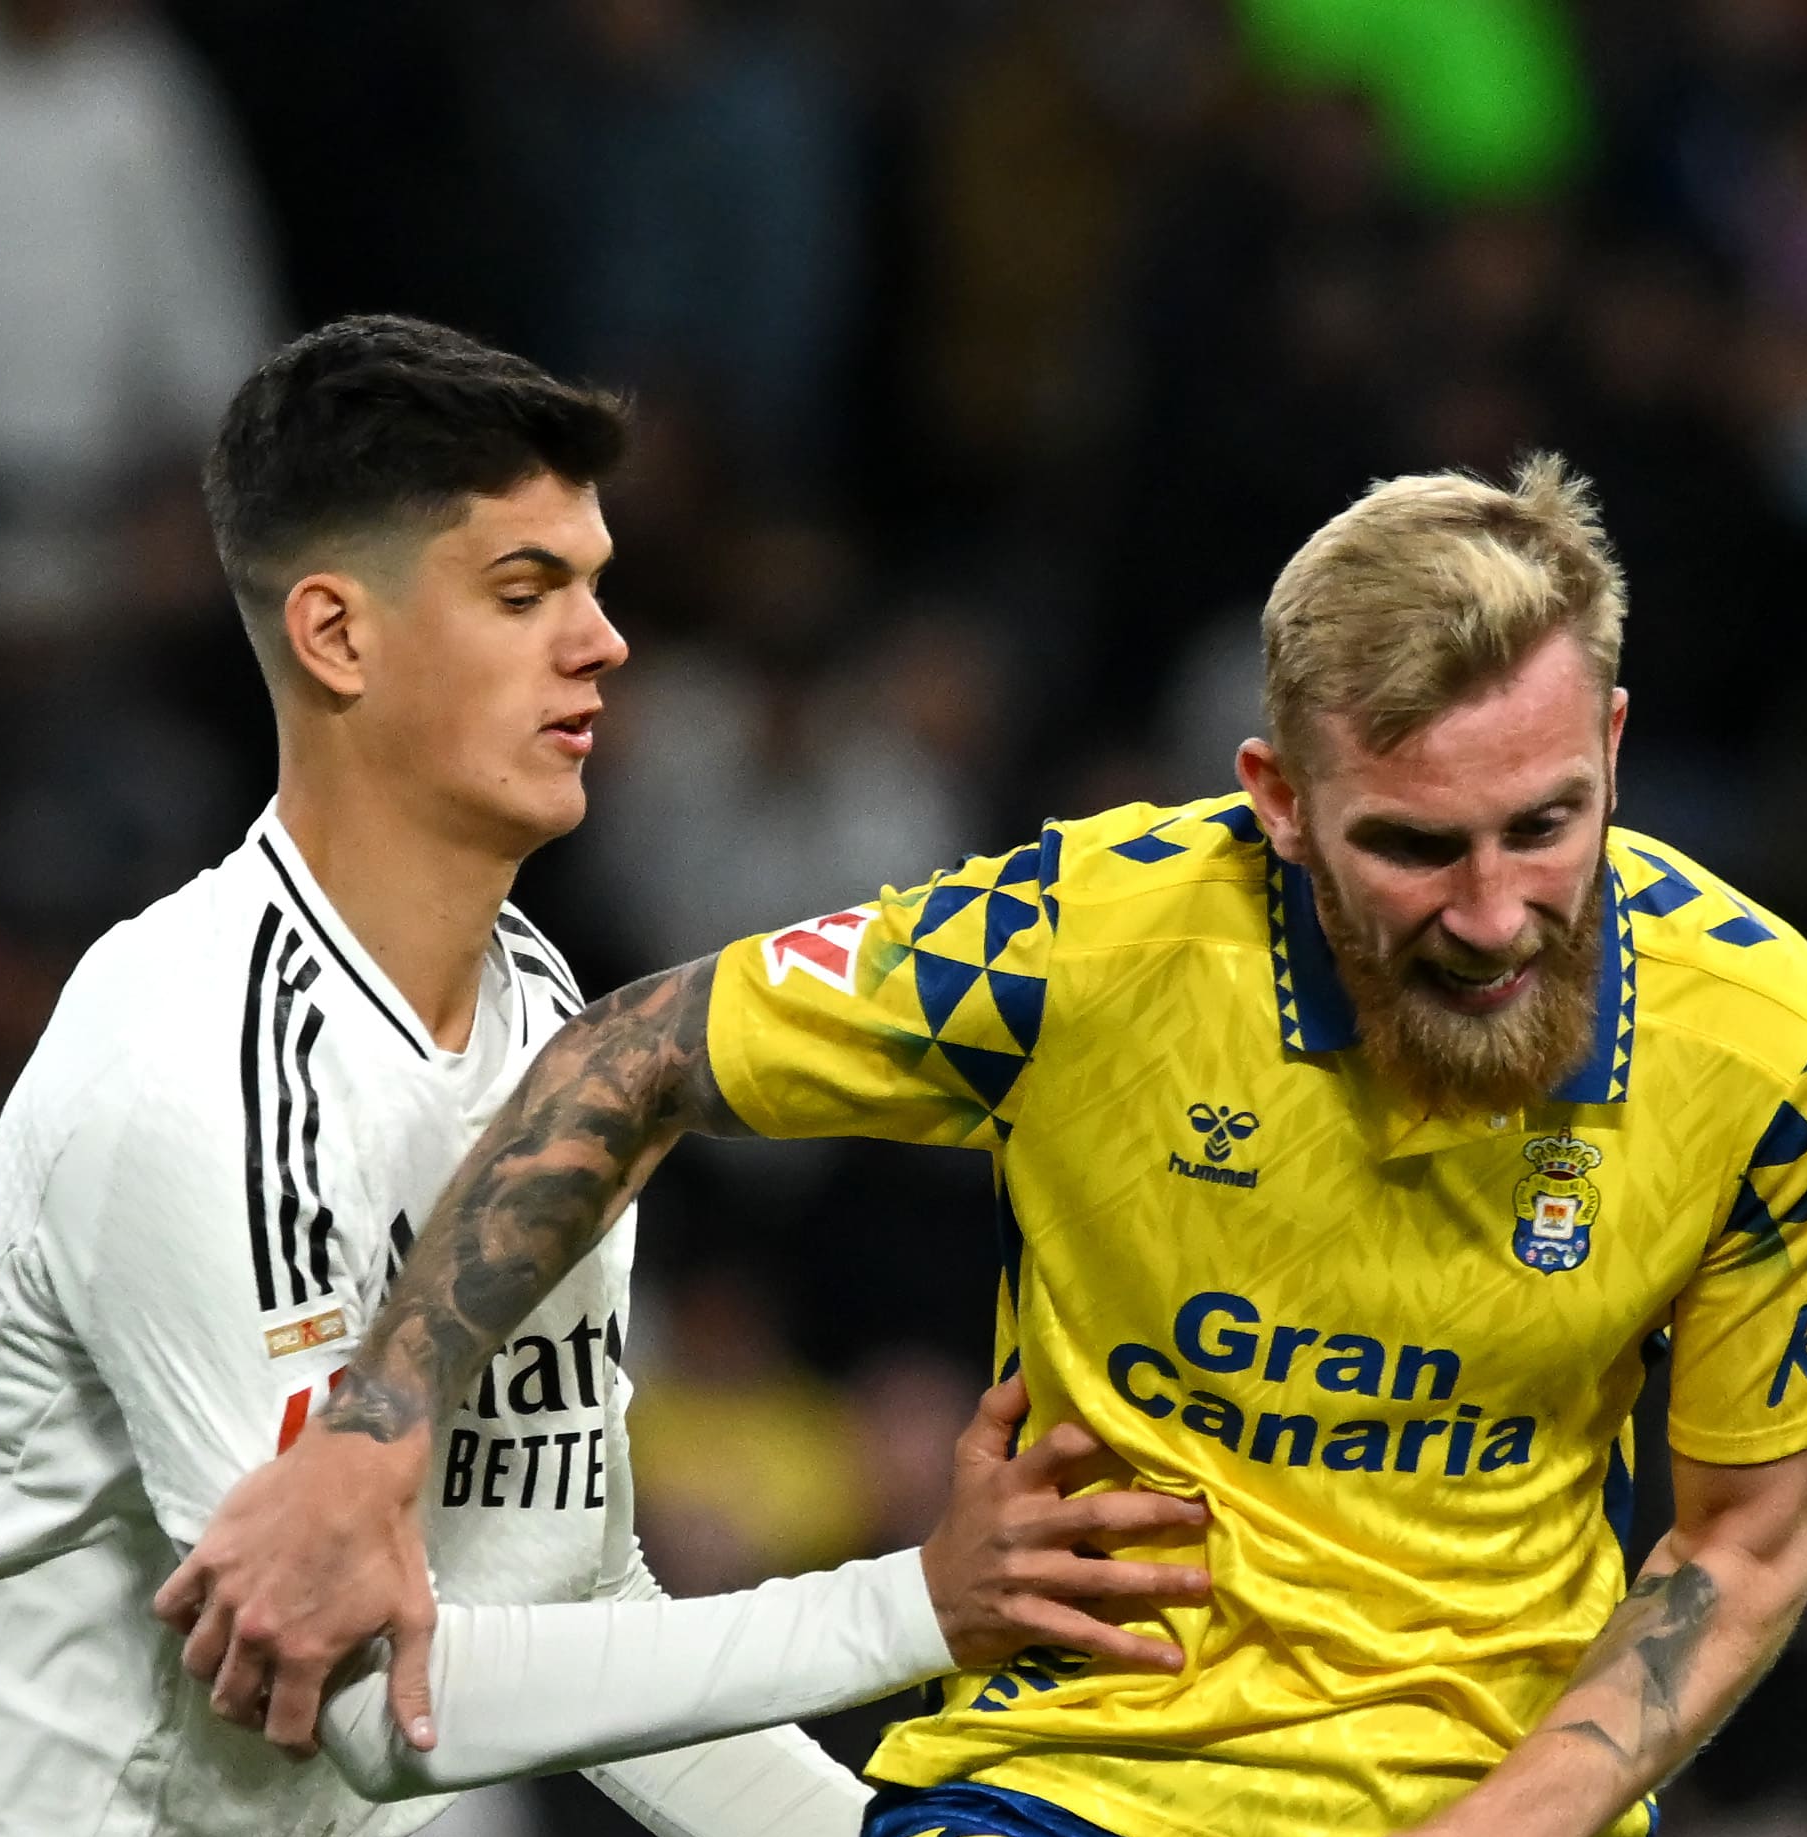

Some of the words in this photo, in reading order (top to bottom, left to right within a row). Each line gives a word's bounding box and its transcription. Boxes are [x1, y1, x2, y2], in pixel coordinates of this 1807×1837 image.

[1168, 1151, 1259, 1189] hummel
[1173, 1291, 1462, 1401] Gran
[1107, 1342, 1537, 1477] Canaria
